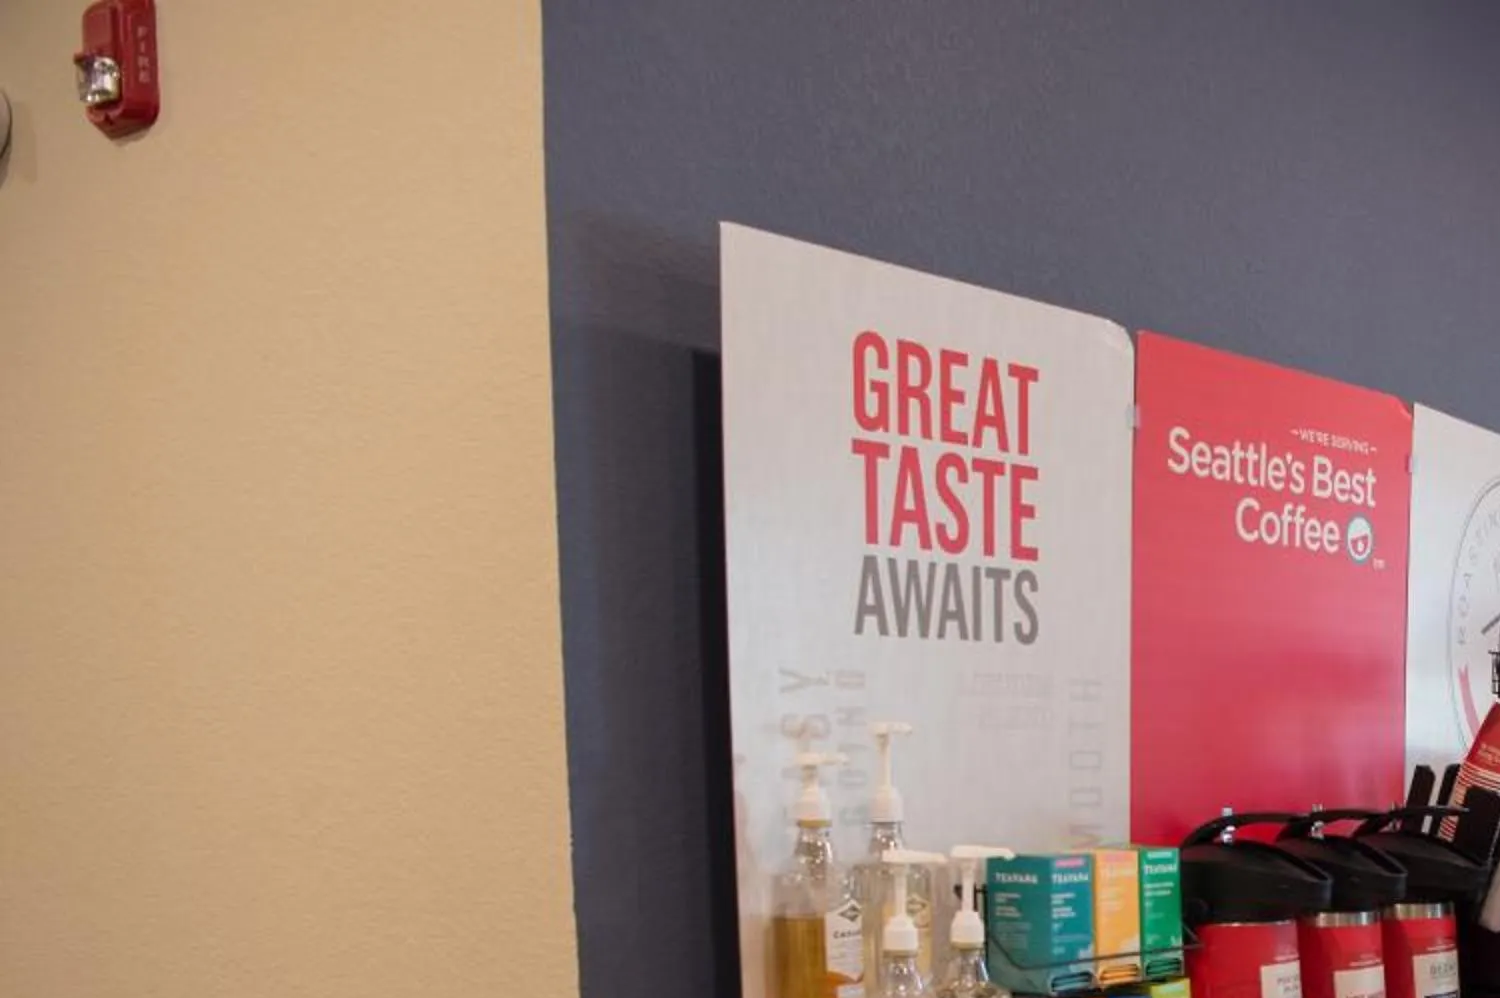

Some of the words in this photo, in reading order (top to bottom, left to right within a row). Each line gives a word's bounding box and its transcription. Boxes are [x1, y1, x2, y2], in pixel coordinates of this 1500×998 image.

[852, 330, 1039, 456] GREAT
[851, 437, 1039, 562] TASTE
[1168, 426, 1305, 494] Seattle's
[1312, 454, 1377, 508] Best
[1236, 497, 1341, 553] Coffee
[854, 555, 1040, 645] AWAITS
